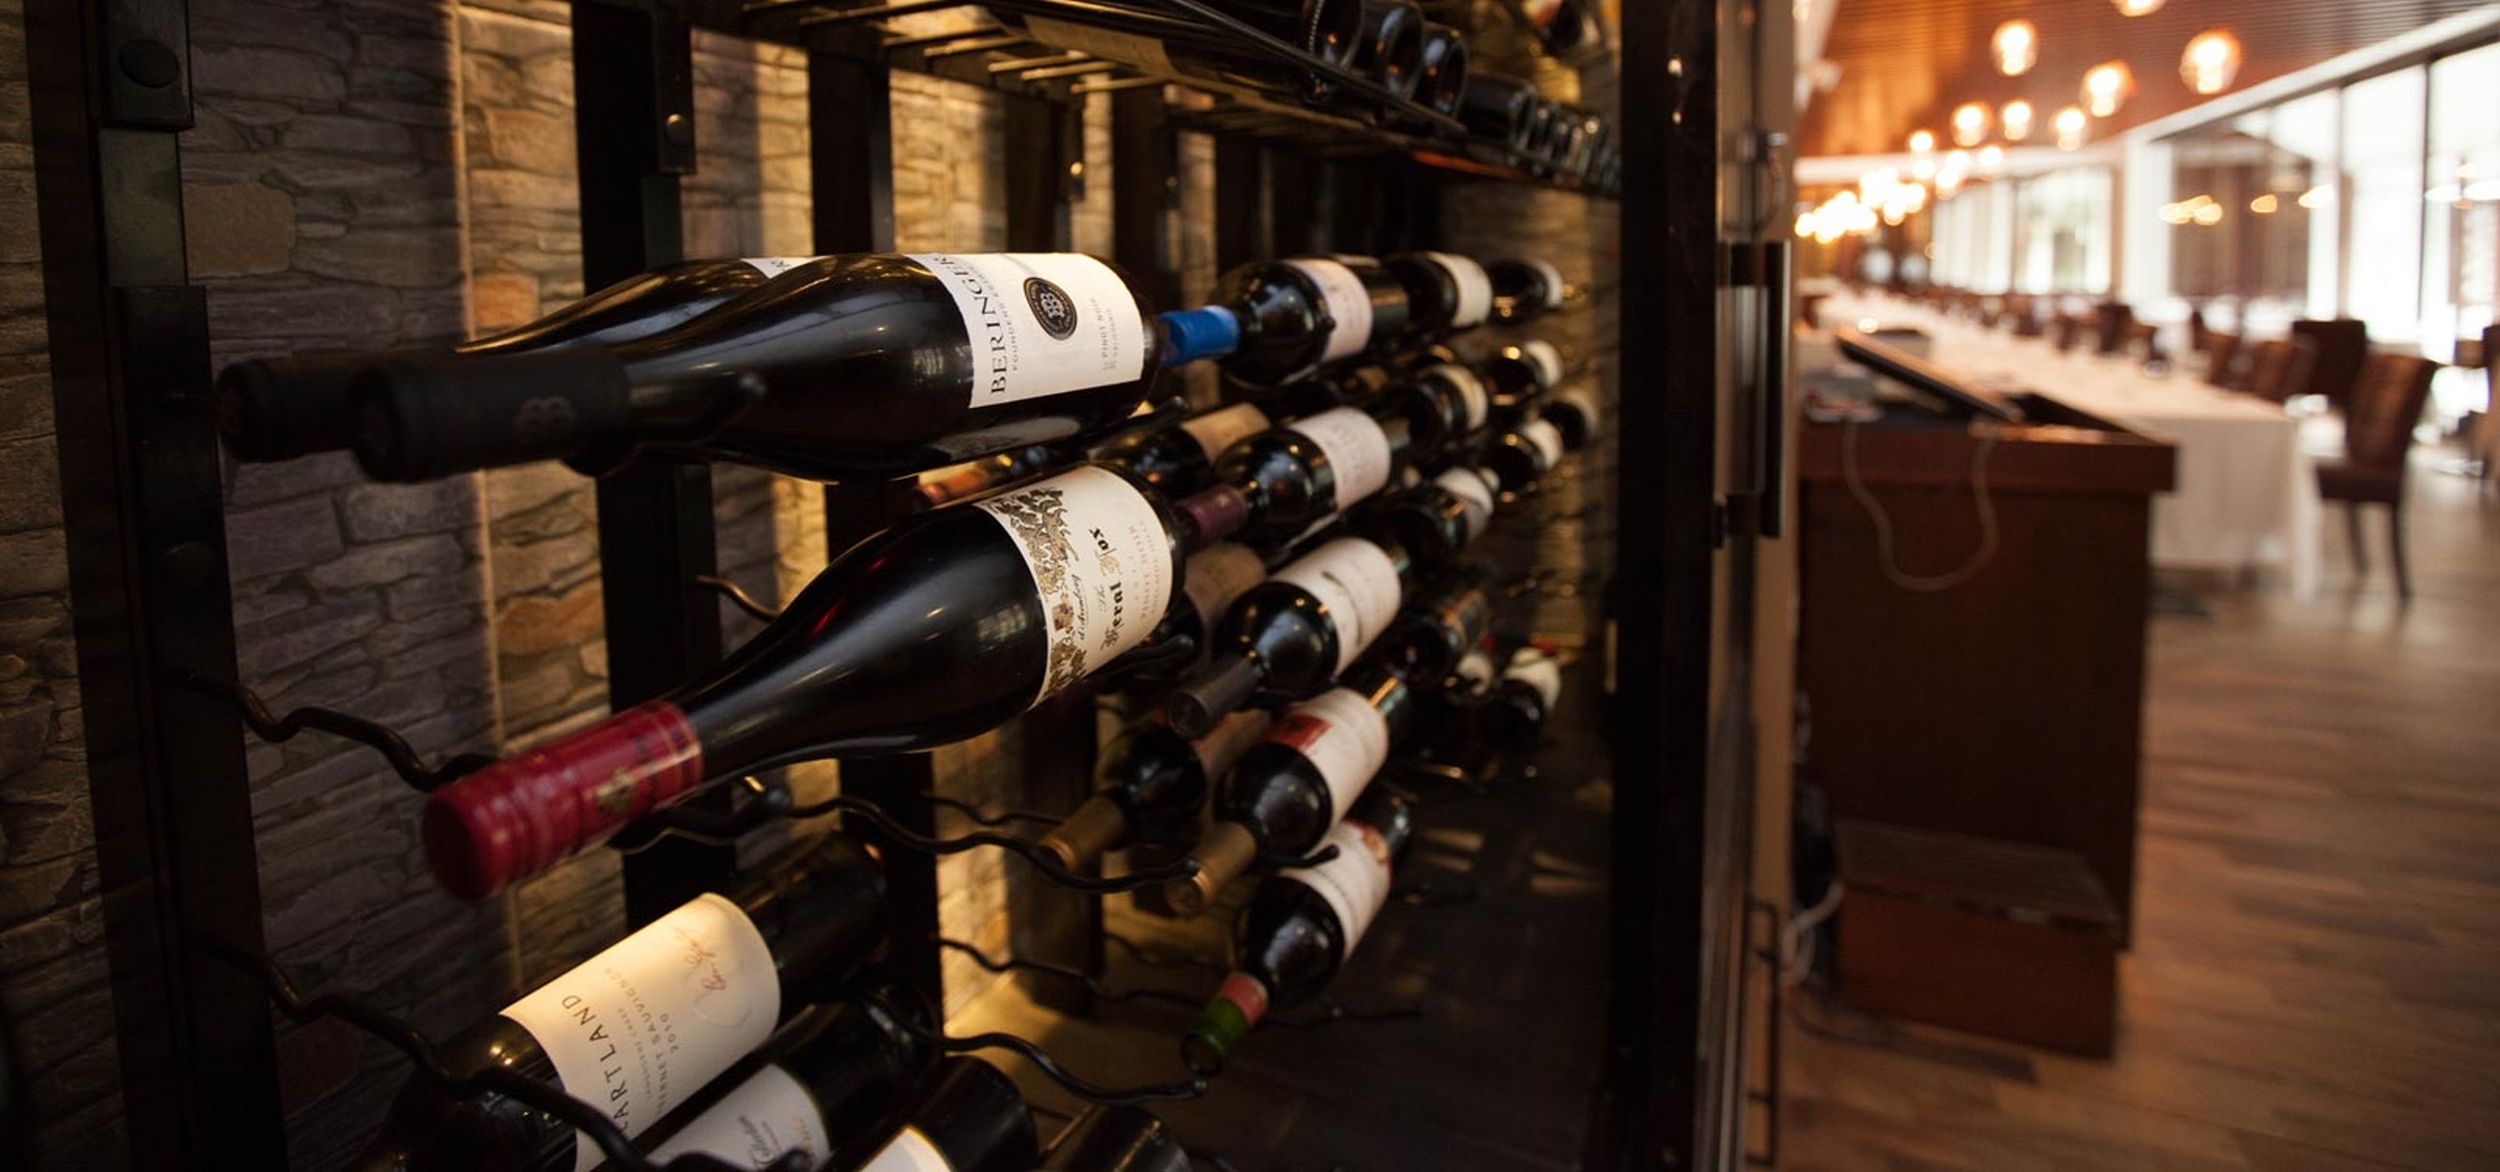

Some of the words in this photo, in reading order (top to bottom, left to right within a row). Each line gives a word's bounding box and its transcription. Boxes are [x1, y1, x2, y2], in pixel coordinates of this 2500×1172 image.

[933, 257, 1007, 395] BERINGER
[1088, 527, 1122, 576] Fox
[1099, 581, 1125, 652] Feral
[660, 1012, 680, 1054] 2010
